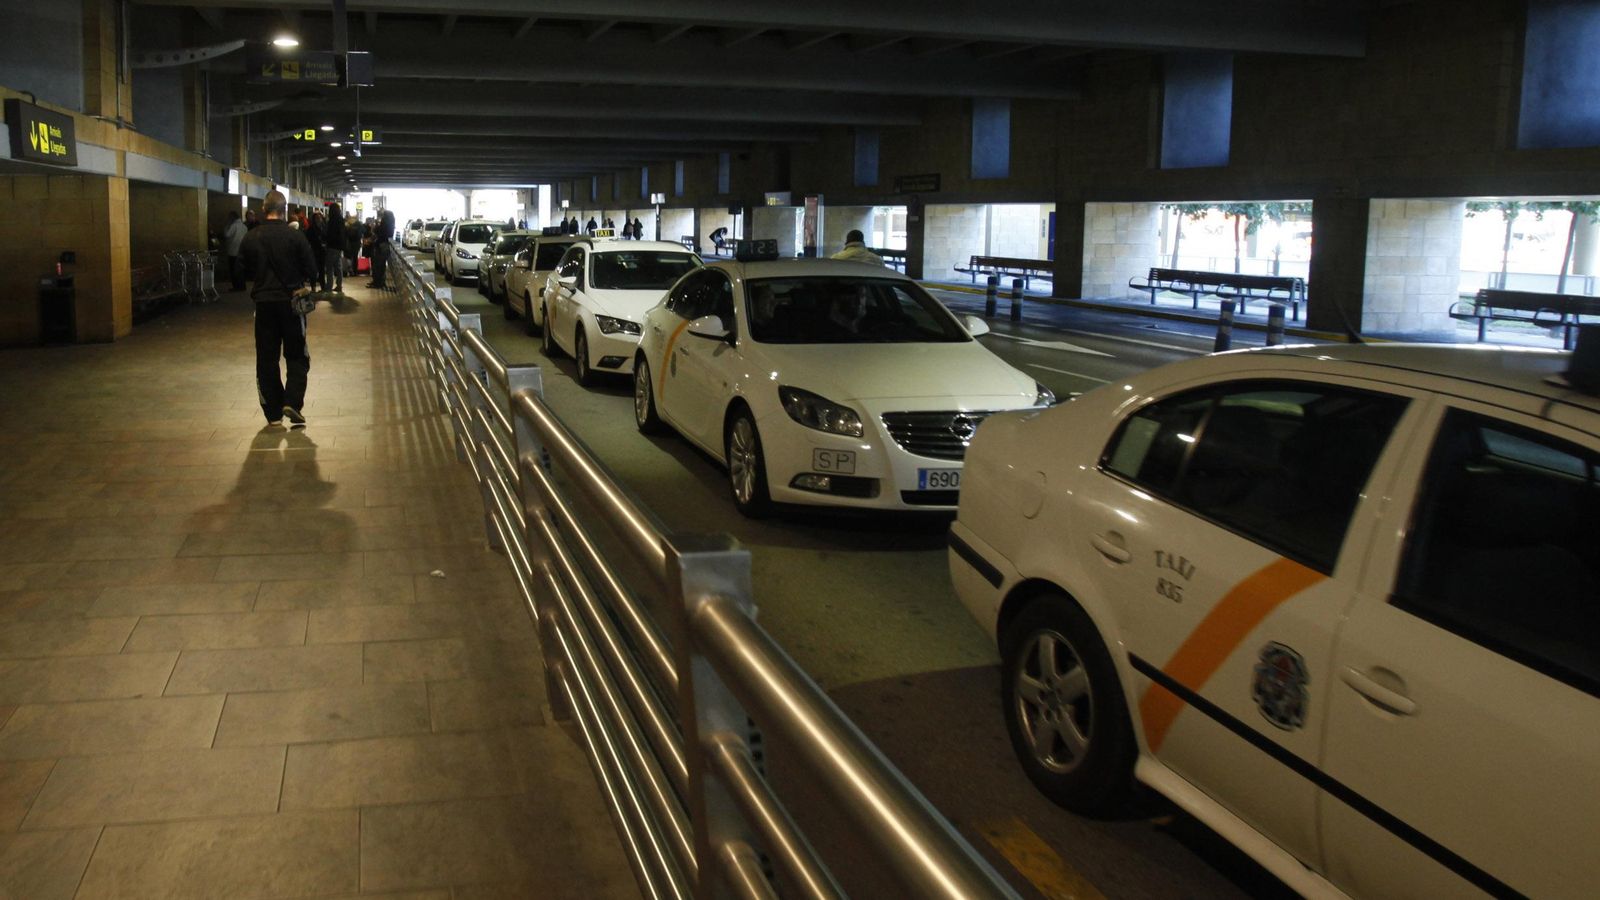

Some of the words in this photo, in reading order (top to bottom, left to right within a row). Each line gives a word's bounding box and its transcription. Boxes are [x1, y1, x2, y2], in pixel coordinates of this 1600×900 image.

[597, 229, 610, 238] TAXI
[818, 451, 850, 470] SP
[929, 471, 960, 488] 690
[1154, 549, 1197, 581] TAXI
